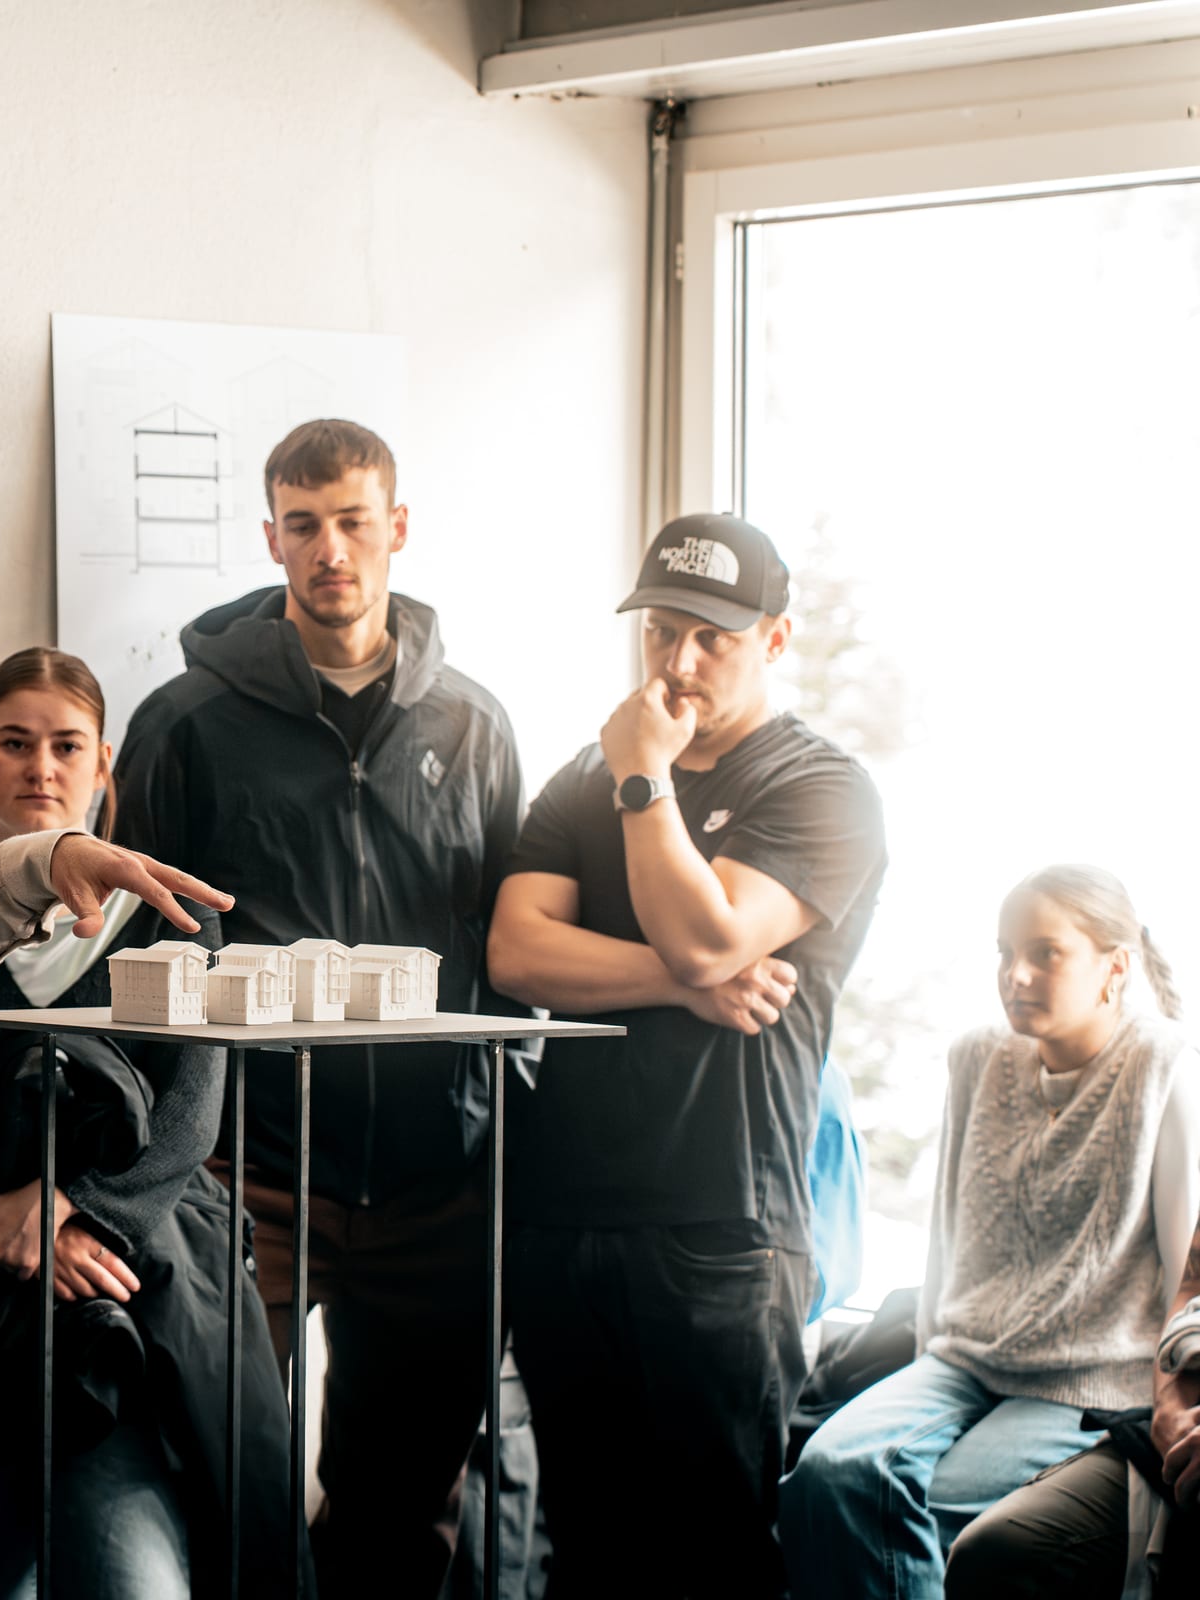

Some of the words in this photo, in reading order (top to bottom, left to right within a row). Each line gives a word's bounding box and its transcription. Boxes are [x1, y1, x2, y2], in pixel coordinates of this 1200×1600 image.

[683, 536, 714, 552] THE
[658, 547, 711, 564] NORTH
[666, 559, 707, 577] FACE
